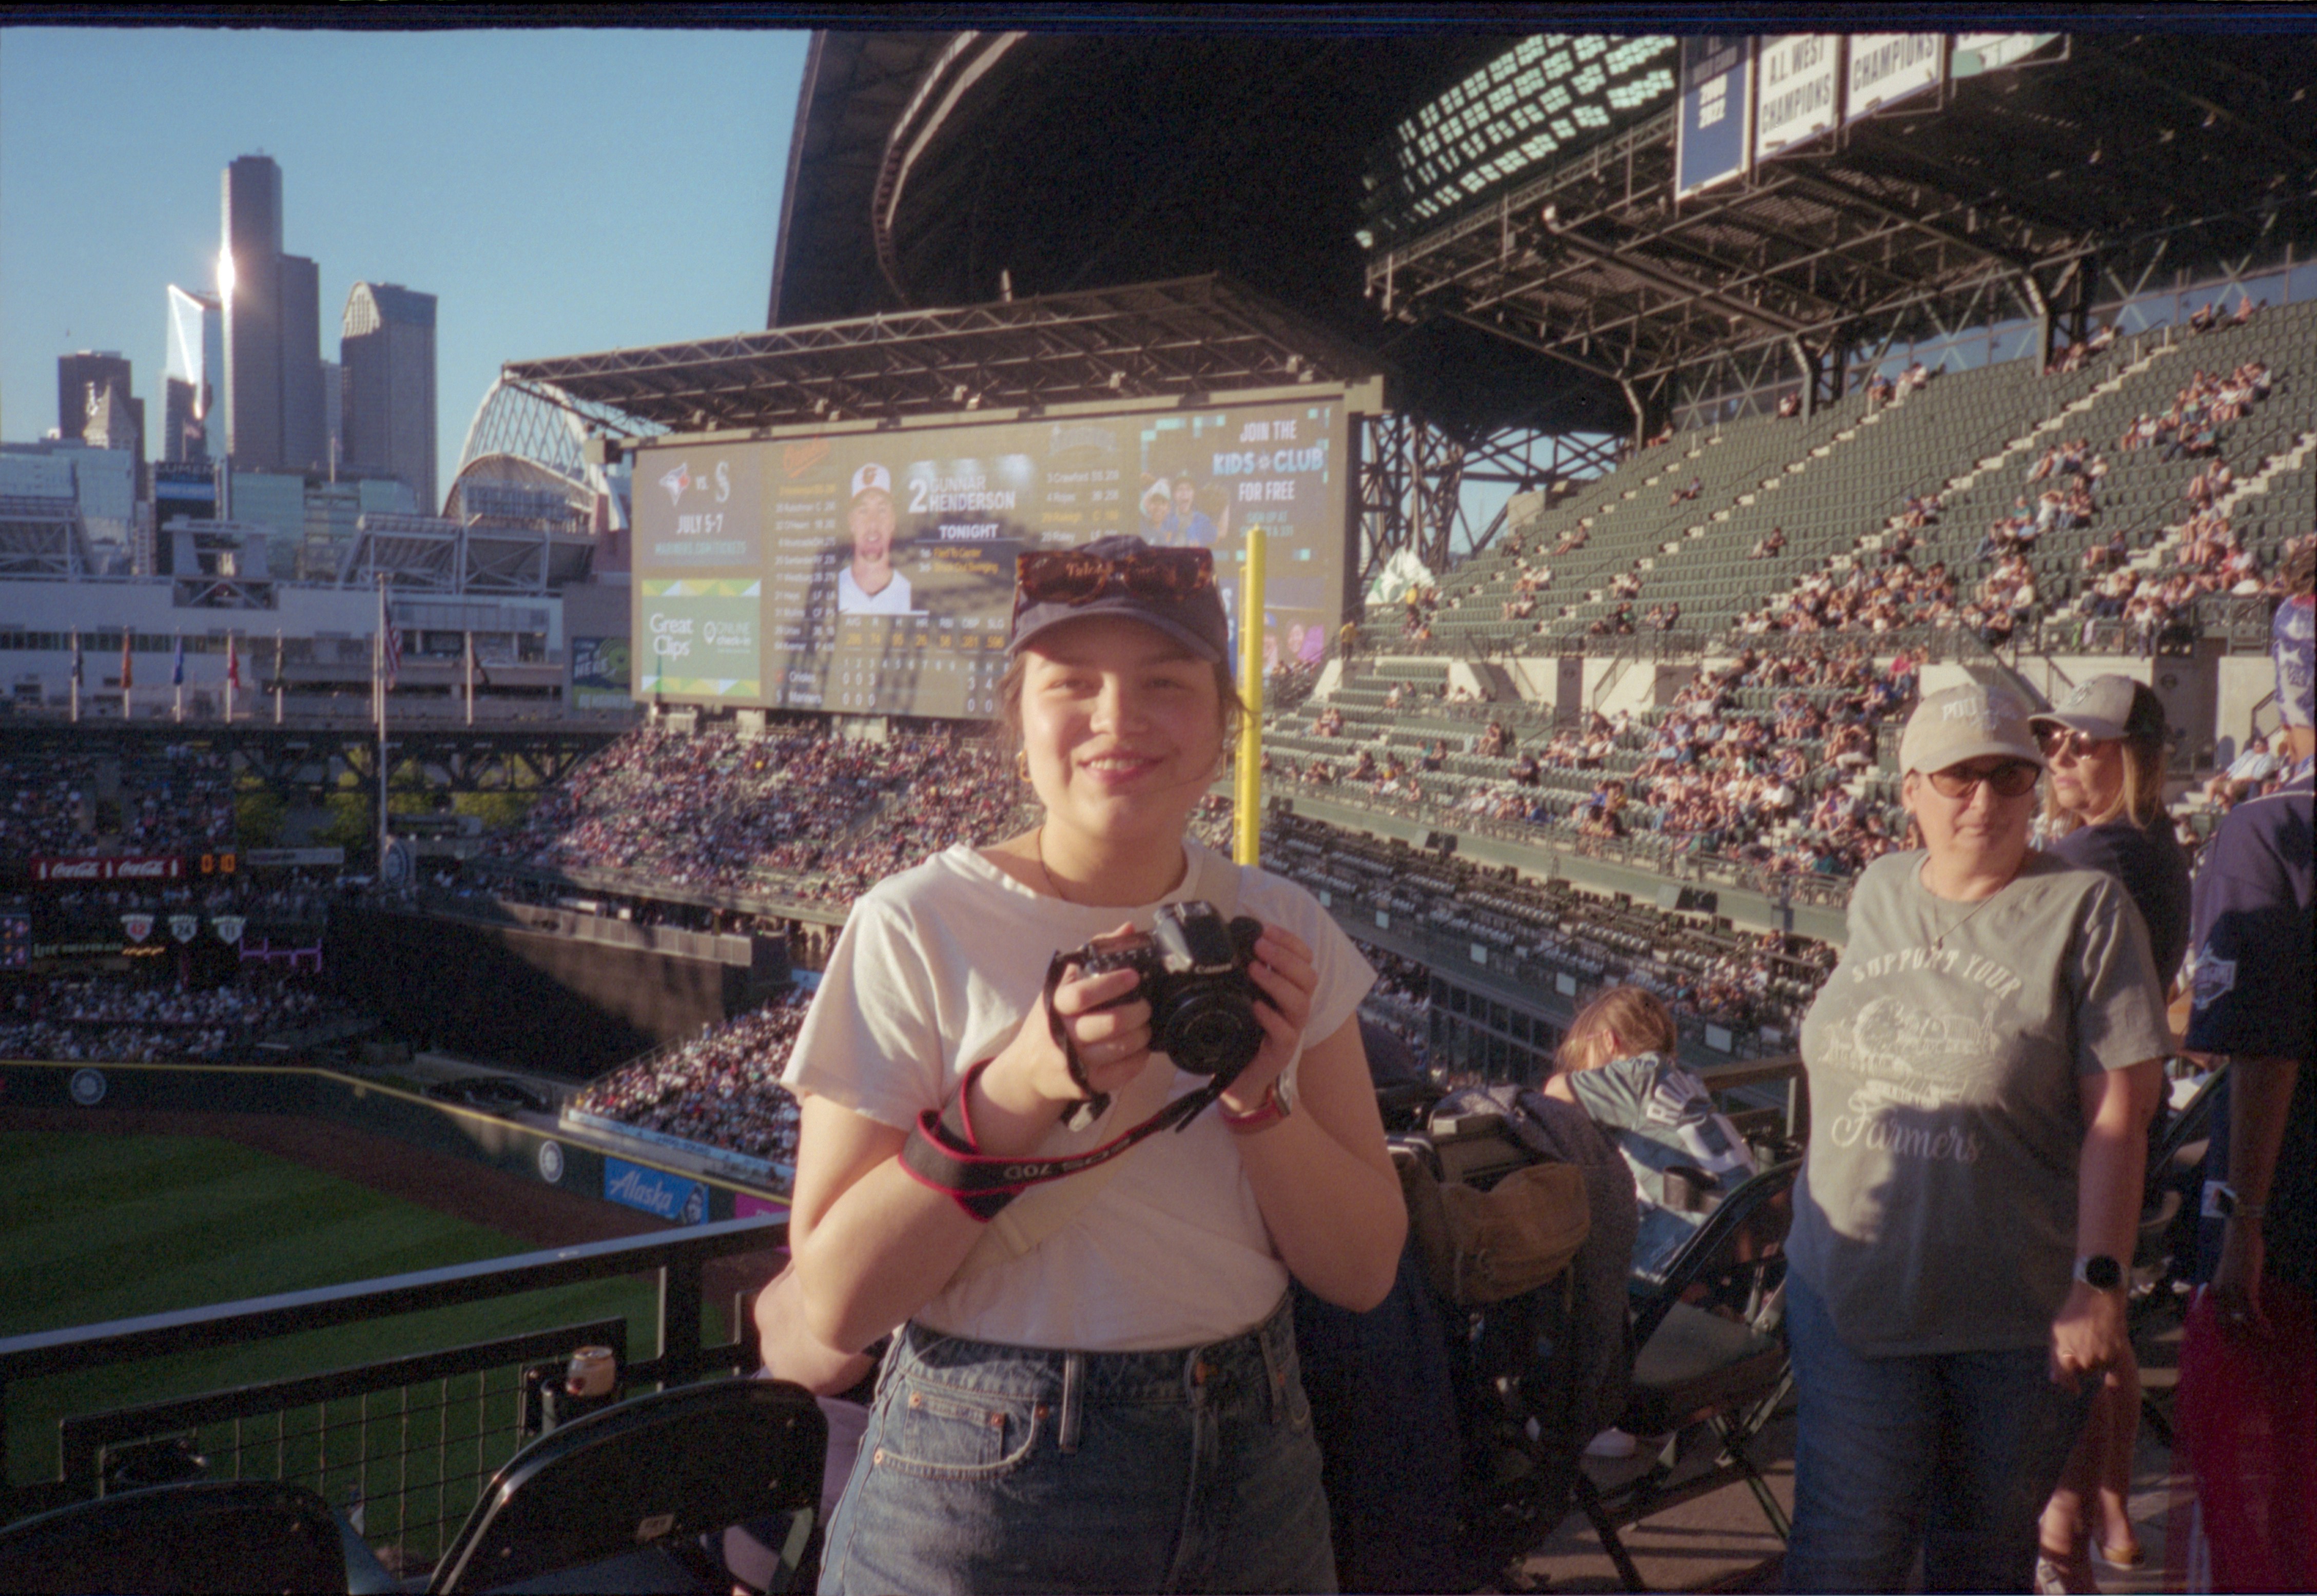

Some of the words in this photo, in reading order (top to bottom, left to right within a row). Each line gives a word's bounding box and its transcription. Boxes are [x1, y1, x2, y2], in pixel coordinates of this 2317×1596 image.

[1792, 35, 1824, 74] WEST
[1853, 34, 1934, 91] CHAMPIONS
[1763, 73, 1831, 134] CHAMPIONS
[1240, 422, 1270, 442] JOIN
[1274, 420, 1297, 439] THE
[1213, 452, 1255, 476] KIDS
[1274, 448, 1324, 473] CLUB
[930, 476, 986, 493] GUNNAR
[1239, 481, 1261, 501] FOR
[1266, 480, 1295, 501] FREE
[908, 479, 927, 513] 2
[929, 491, 1016, 512] HENDERSON
[676, 514, 702, 534] JULY
[705, 513, 723, 533] 5-7
[939, 523, 999, 539] TONIGHT
[650, 613, 694, 633] Great
[653, 634, 691, 661] Clips
[843, 672, 850, 685] 0
[855, 673, 863, 686] 0
[868, 673, 875, 686] 3
[968, 676, 975, 691] 3
[985, 677, 992, 691] 4
[788, 692, 822, 704] Mariners
[842, 693, 849, 706] 0
[855, 693, 863, 707] 0
[868, 694, 875, 707] 0
[967, 699, 975, 712] 0
[985, 699, 992, 713] 0
[51, 862, 100, 878] Coca-Cola
[118, 861, 165, 877] Coca-Cola
[131, 923, 146, 935] 42
[178, 924, 191, 937] 24
[1193, 963, 1233, 975] Canon
[1852, 949, 1960, 984] SUPPORT
[1962, 953, 2021, 999] YOUR
[1831, 1088, 1981, 1164] Farmers
[1003, 1164, 1052, 1180] 70D
[610, 1170, 675, 1212] Alaska
